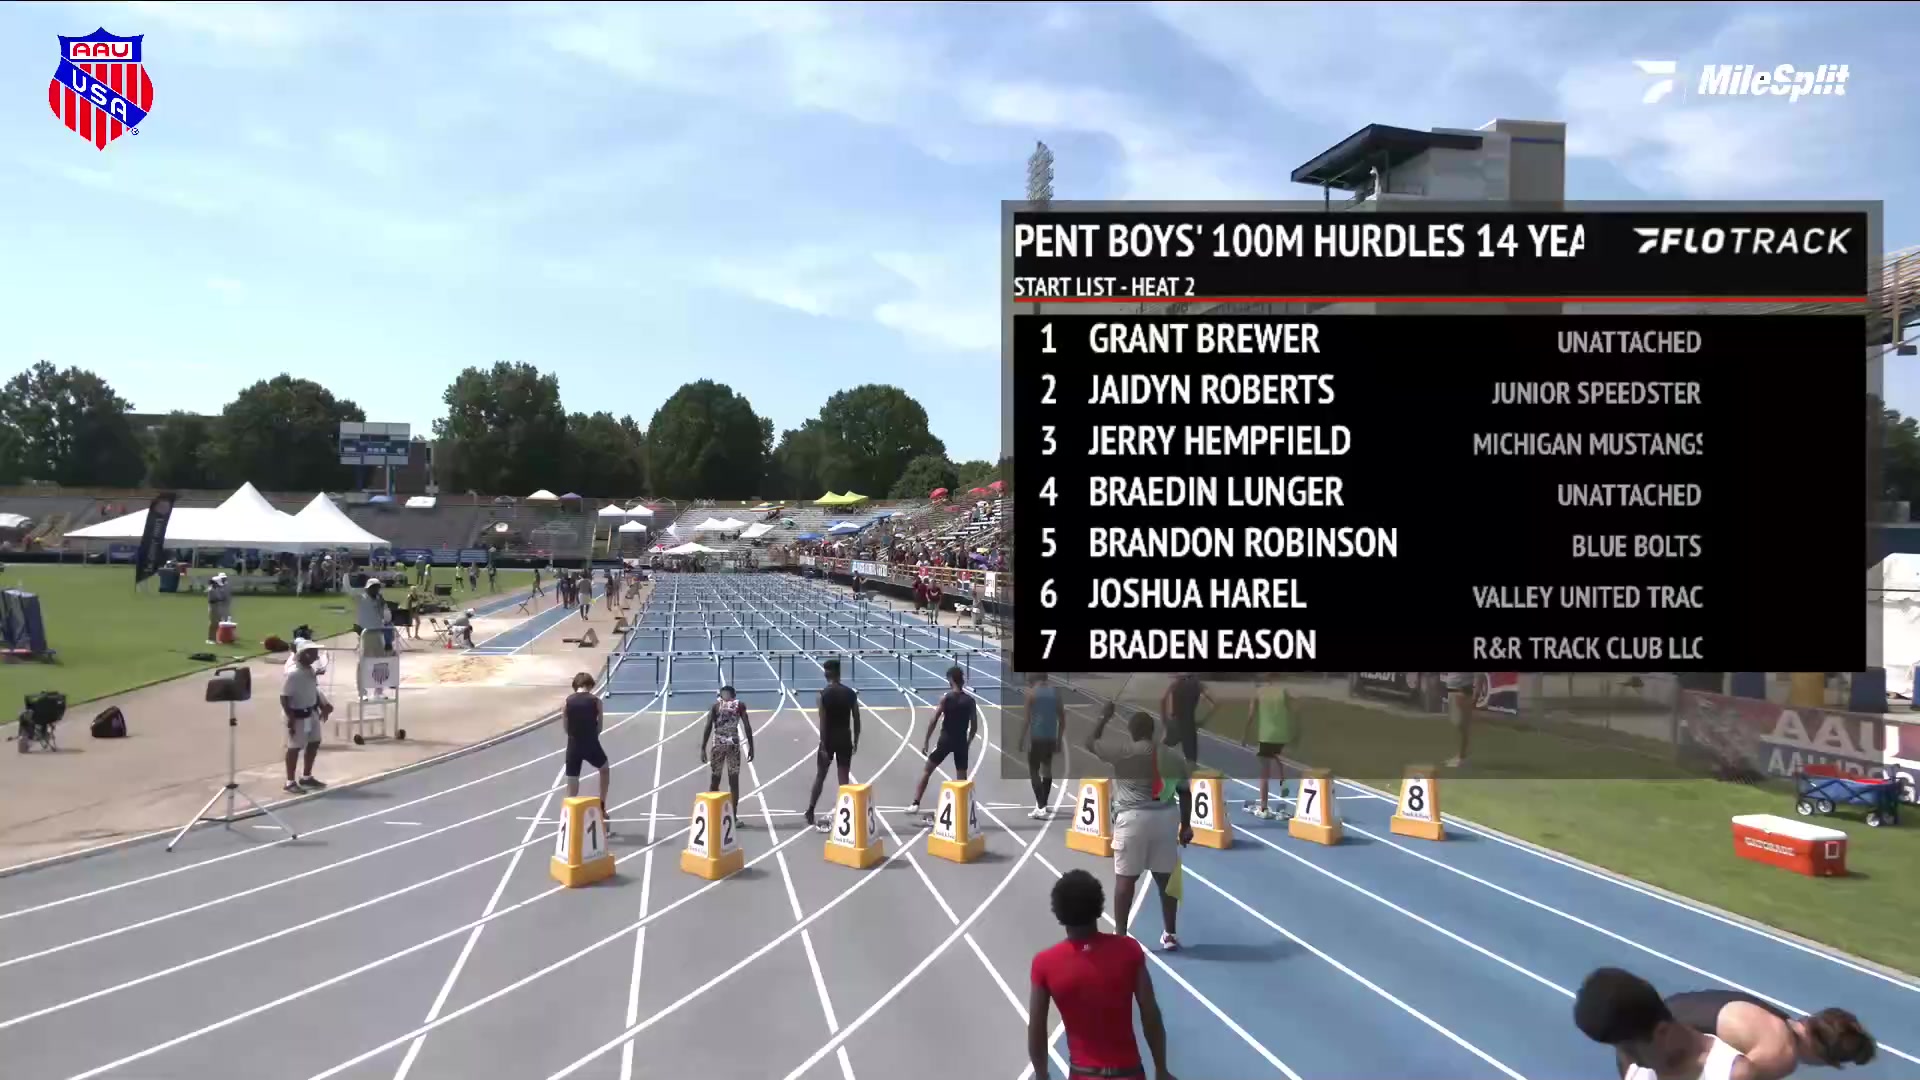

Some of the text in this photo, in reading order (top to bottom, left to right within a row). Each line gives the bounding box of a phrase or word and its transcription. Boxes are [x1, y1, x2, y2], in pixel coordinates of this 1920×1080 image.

[1081, 798, 1095, 825] 5
[1195, 792, 1208, 818] 6
[1304, 789, 1317, 814] 7
[1408, 785, 1424, 811] 8
[838, 808, 851, 836] 3
[867, 806, 876, 835] 3
[939, 802, 952, 831] 4
[969, 800, 977, 829] 4
[561, 821, 567, 852] 1
[587, 820, 597, 850] 1
[693, 815, 706, 846] 2
[722, 815, 733, 846] 2
